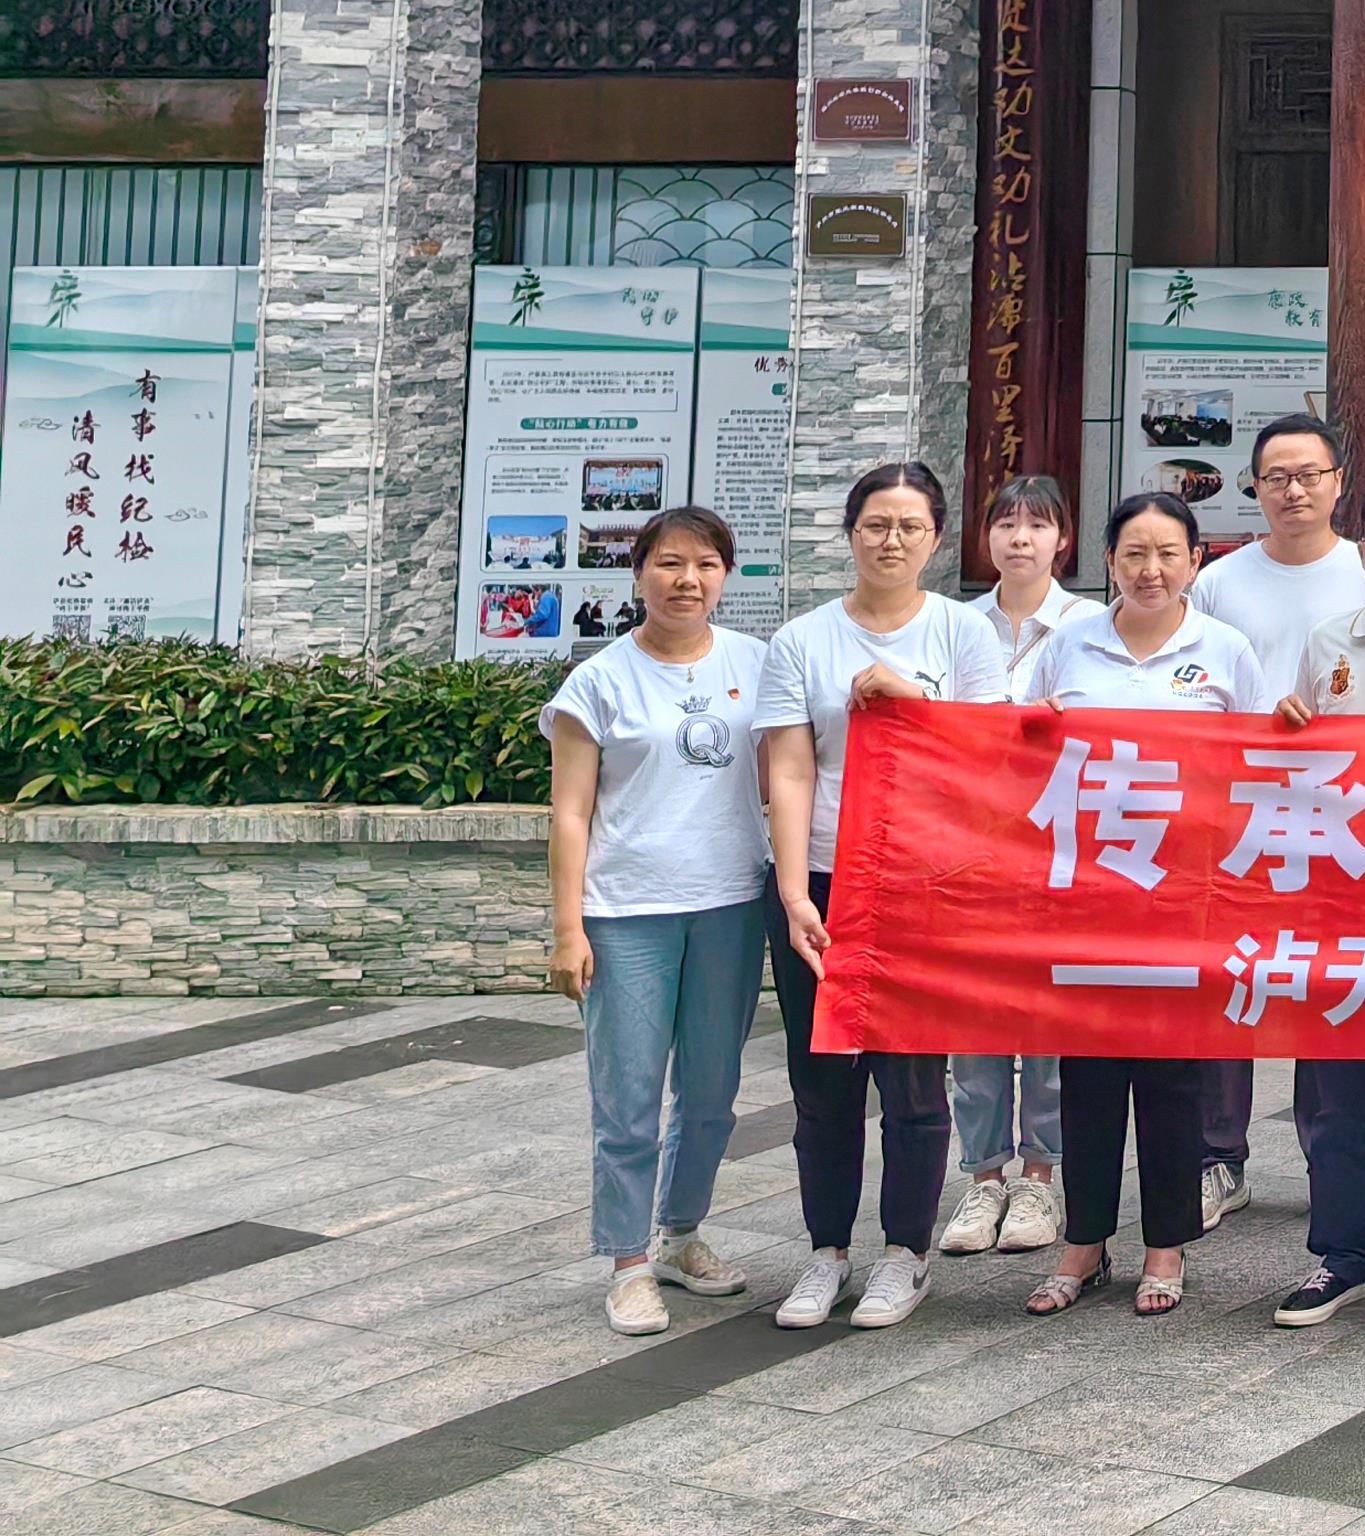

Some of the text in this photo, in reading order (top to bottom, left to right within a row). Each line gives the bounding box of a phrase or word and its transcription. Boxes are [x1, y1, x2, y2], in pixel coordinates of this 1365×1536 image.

[58, 410, 102, 589] 清风暖民心
[114, 368, 162, 564] 有事找纪检
